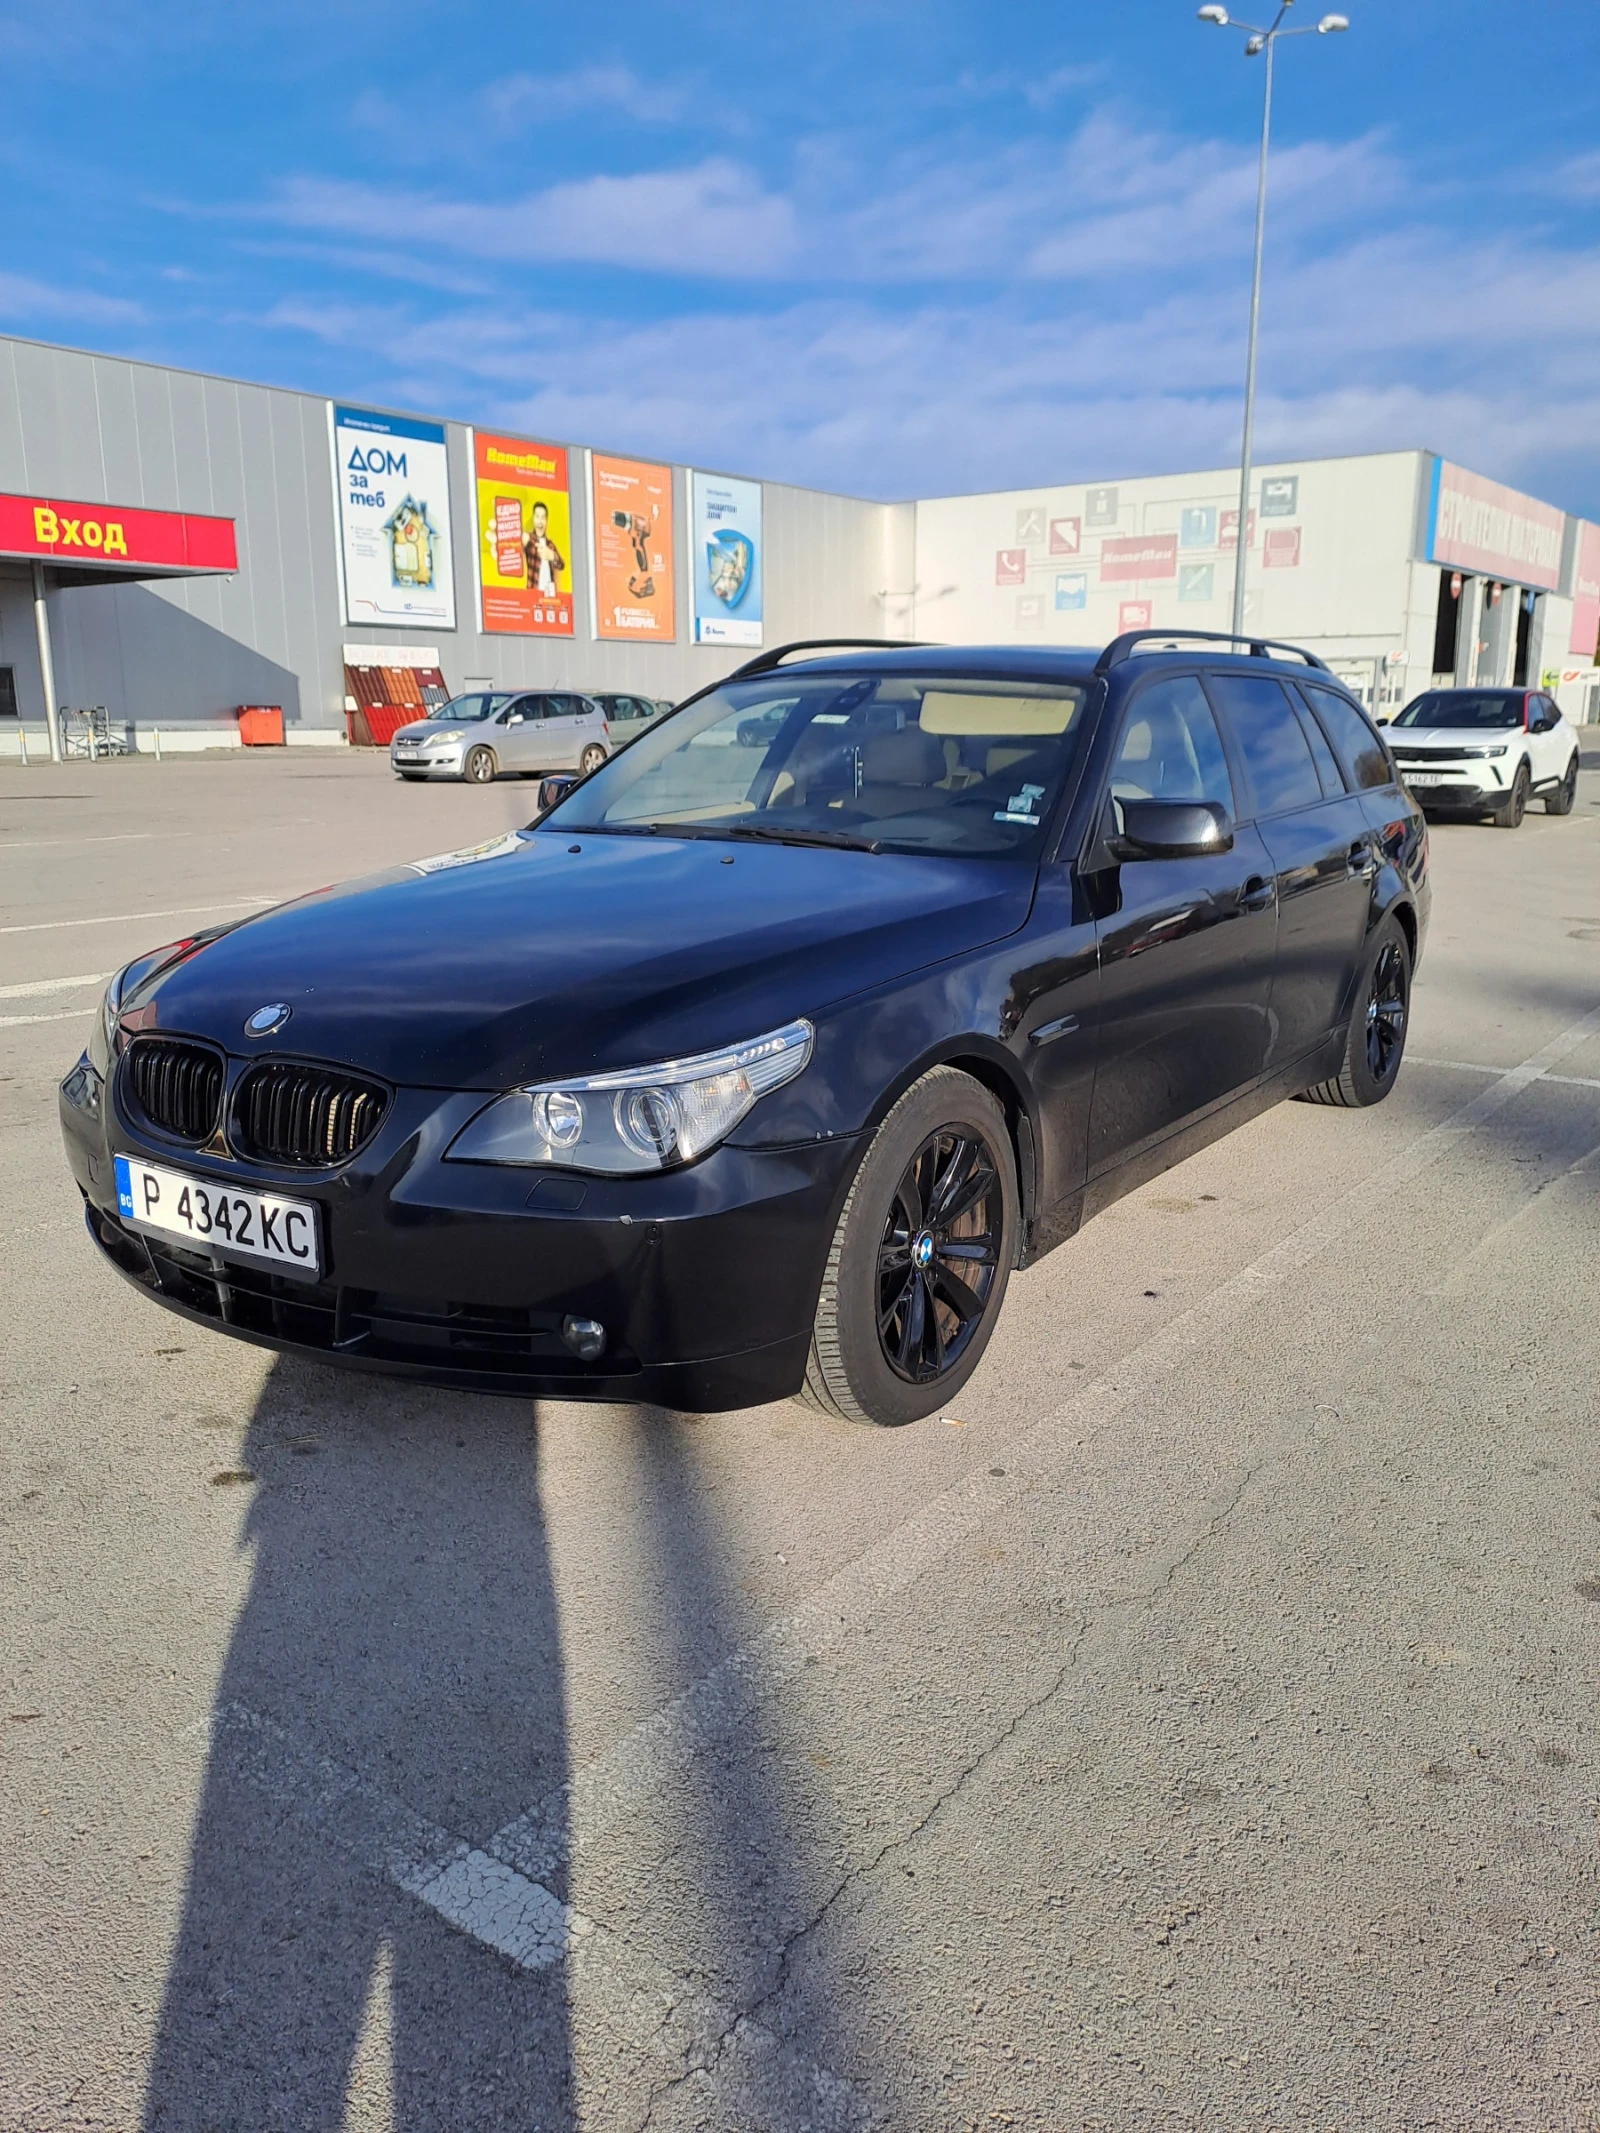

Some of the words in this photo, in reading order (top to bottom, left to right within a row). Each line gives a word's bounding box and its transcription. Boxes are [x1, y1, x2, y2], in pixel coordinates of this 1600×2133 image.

[347, 444, 407, 478] ДОМ
[486, 447, 556, 474] HomeMax
[349, 474, 368, 489] за
[350, 490, 385, 509] теб
[33, 506, 128, 555] Вход
[1102, 549, 1173, 565] HomeMax
[119, 1193, 133, 1209] BG
[142, 1173, 160, 1216] P
[177, 1185, 309, 1259] 4342KC
